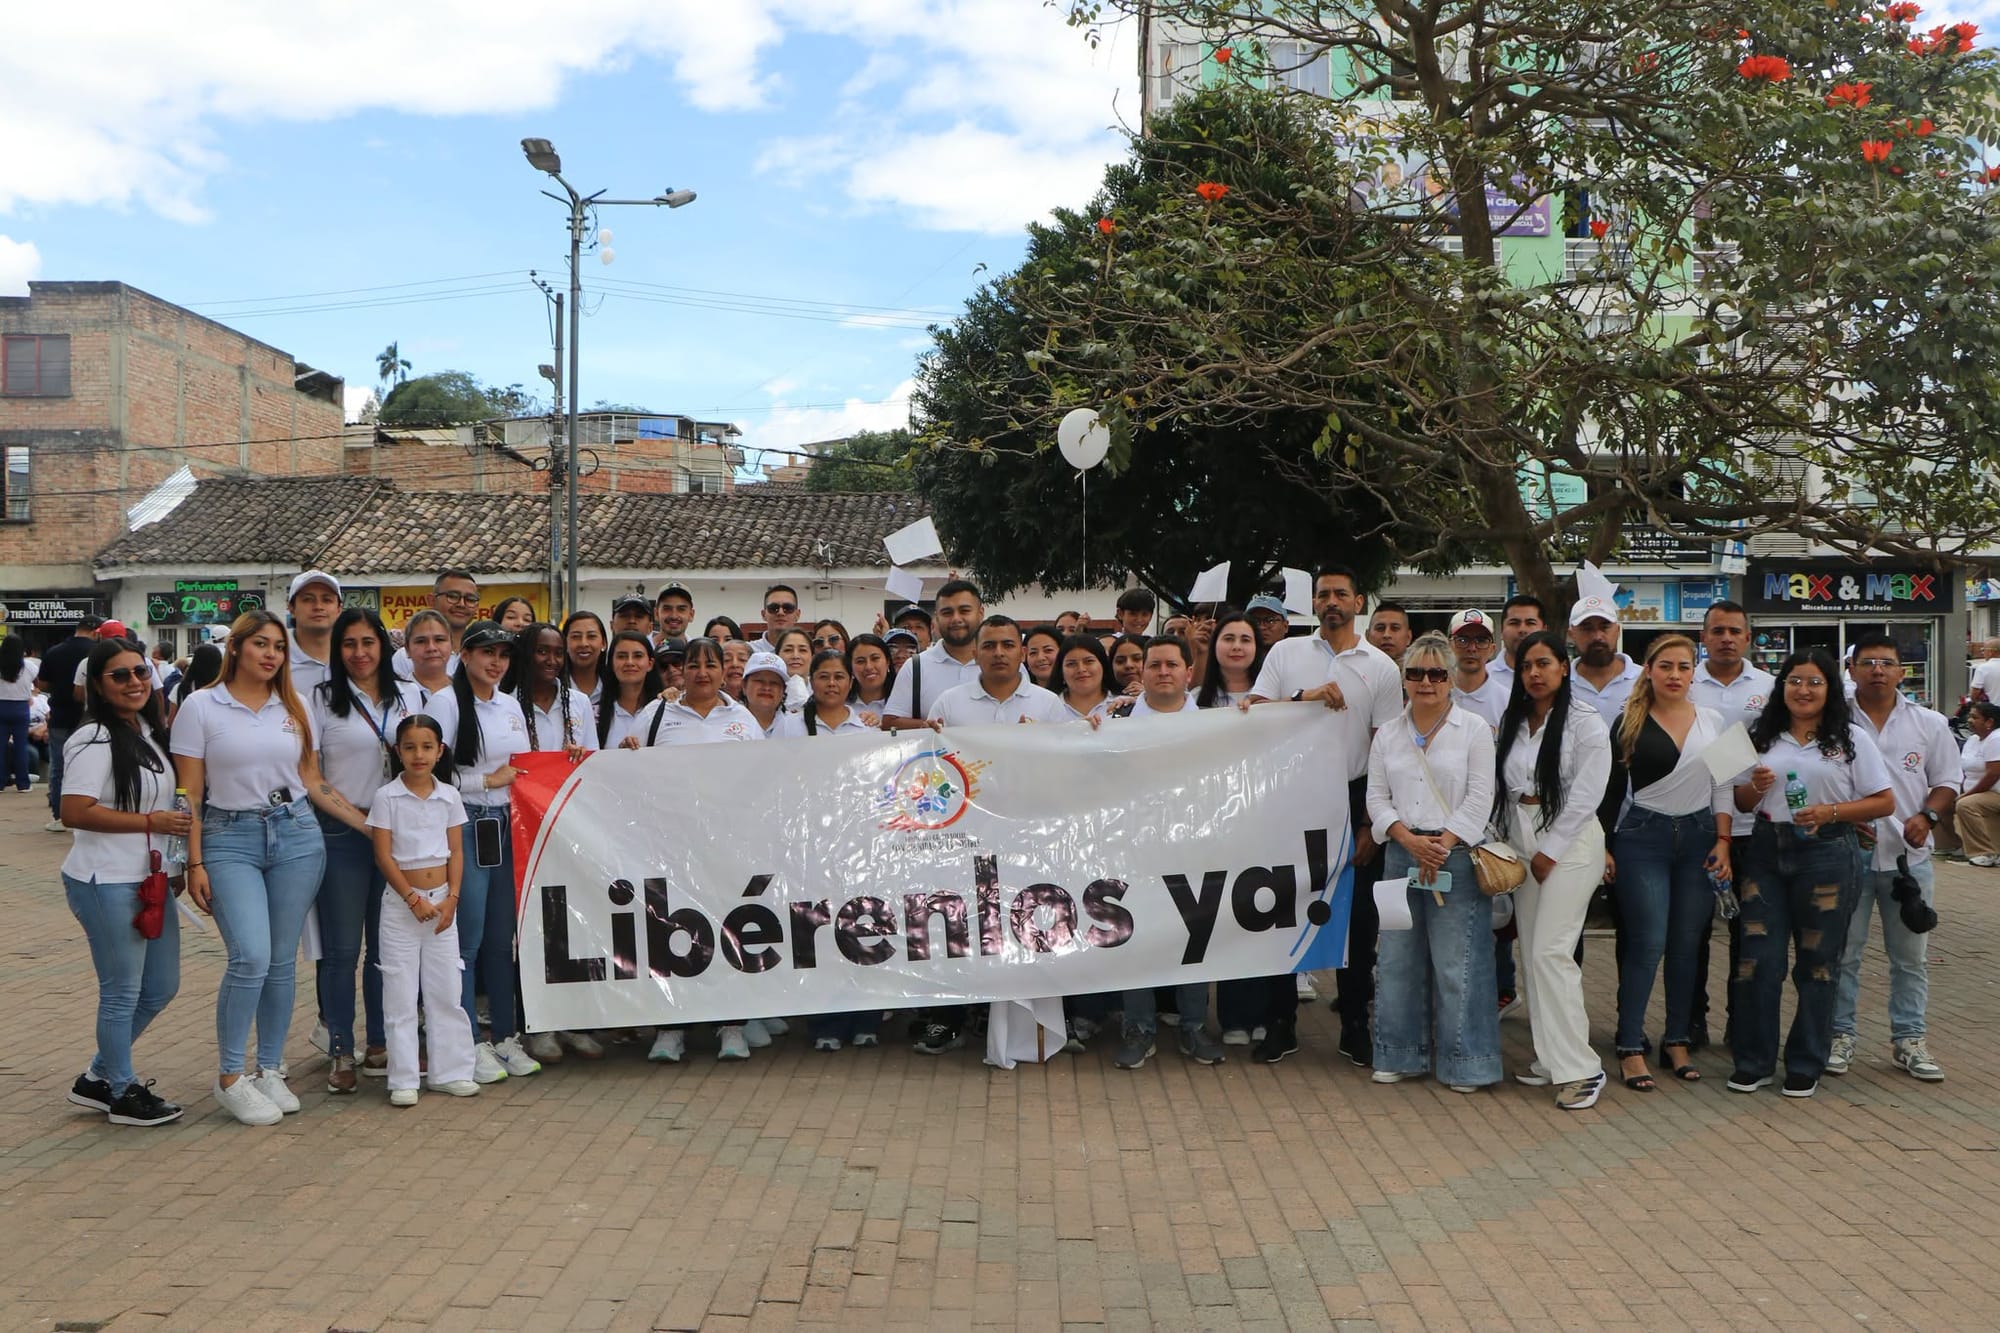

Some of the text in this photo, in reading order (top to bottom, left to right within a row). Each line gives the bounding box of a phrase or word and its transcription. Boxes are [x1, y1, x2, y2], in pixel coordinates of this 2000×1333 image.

[1838, 575, 1861, 600] &
[28, 601, 66, 610] CENTRAL
[10, 610, 84, 619] TIENDA Y LICORES
[541, 828, 1332, 985] Libérenlos ya!
